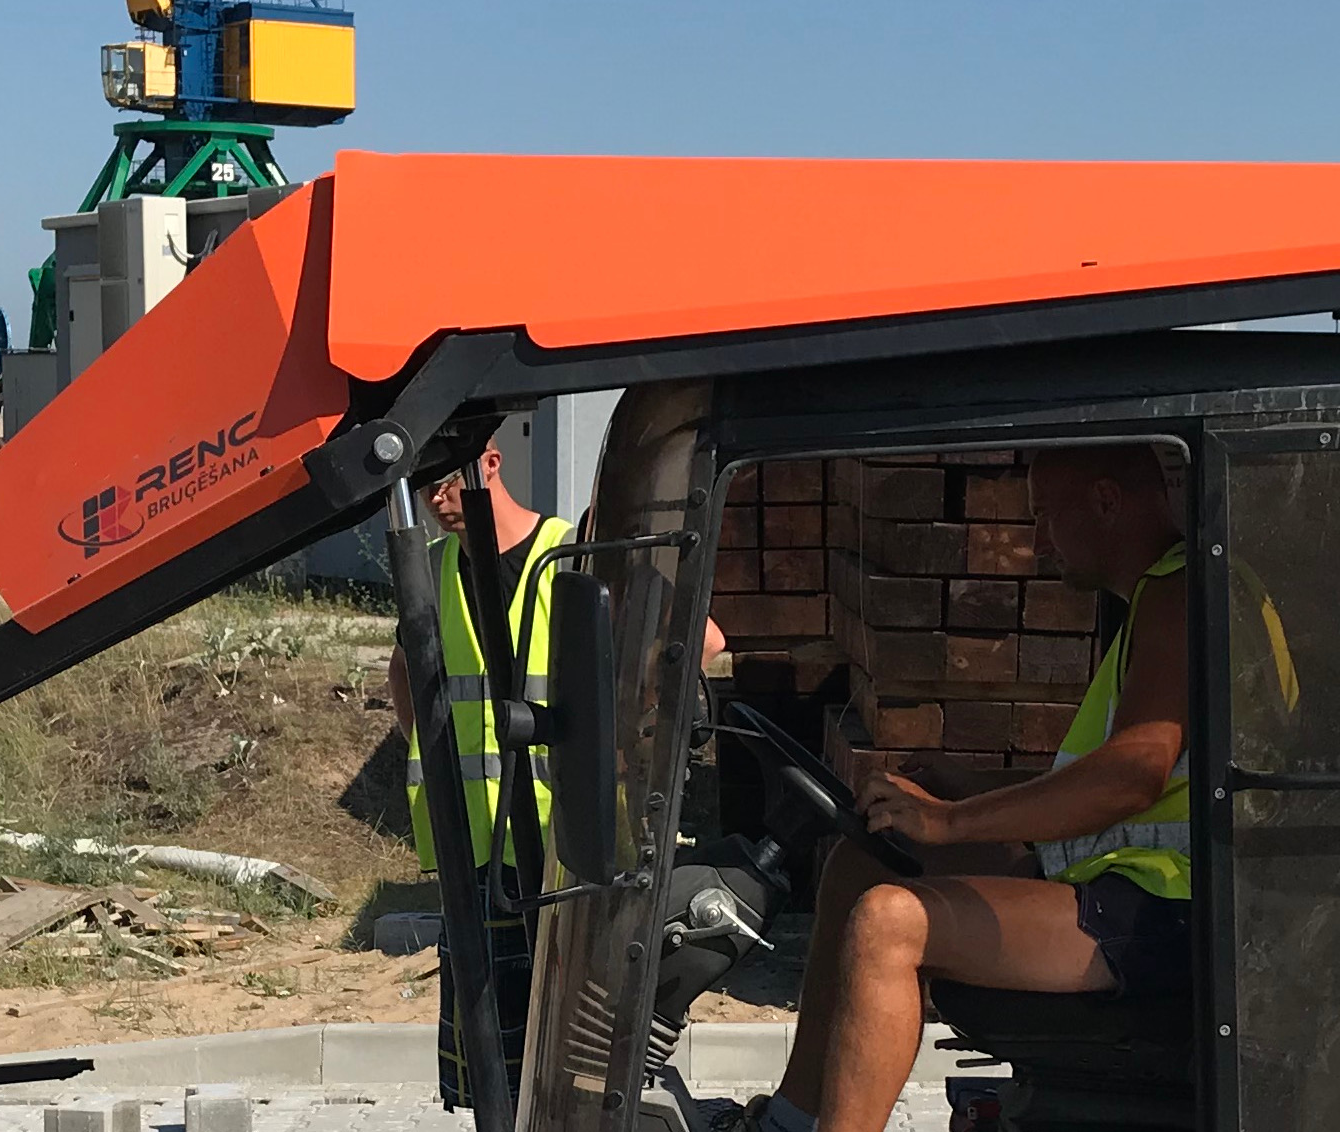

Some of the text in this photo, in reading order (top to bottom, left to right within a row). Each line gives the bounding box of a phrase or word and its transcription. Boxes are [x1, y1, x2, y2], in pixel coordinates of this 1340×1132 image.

[212, 163, 235, 182] 25
[135, 410, 258, 503] RENC
[147, 447, 259, 520] BRUĢĒŠANA
